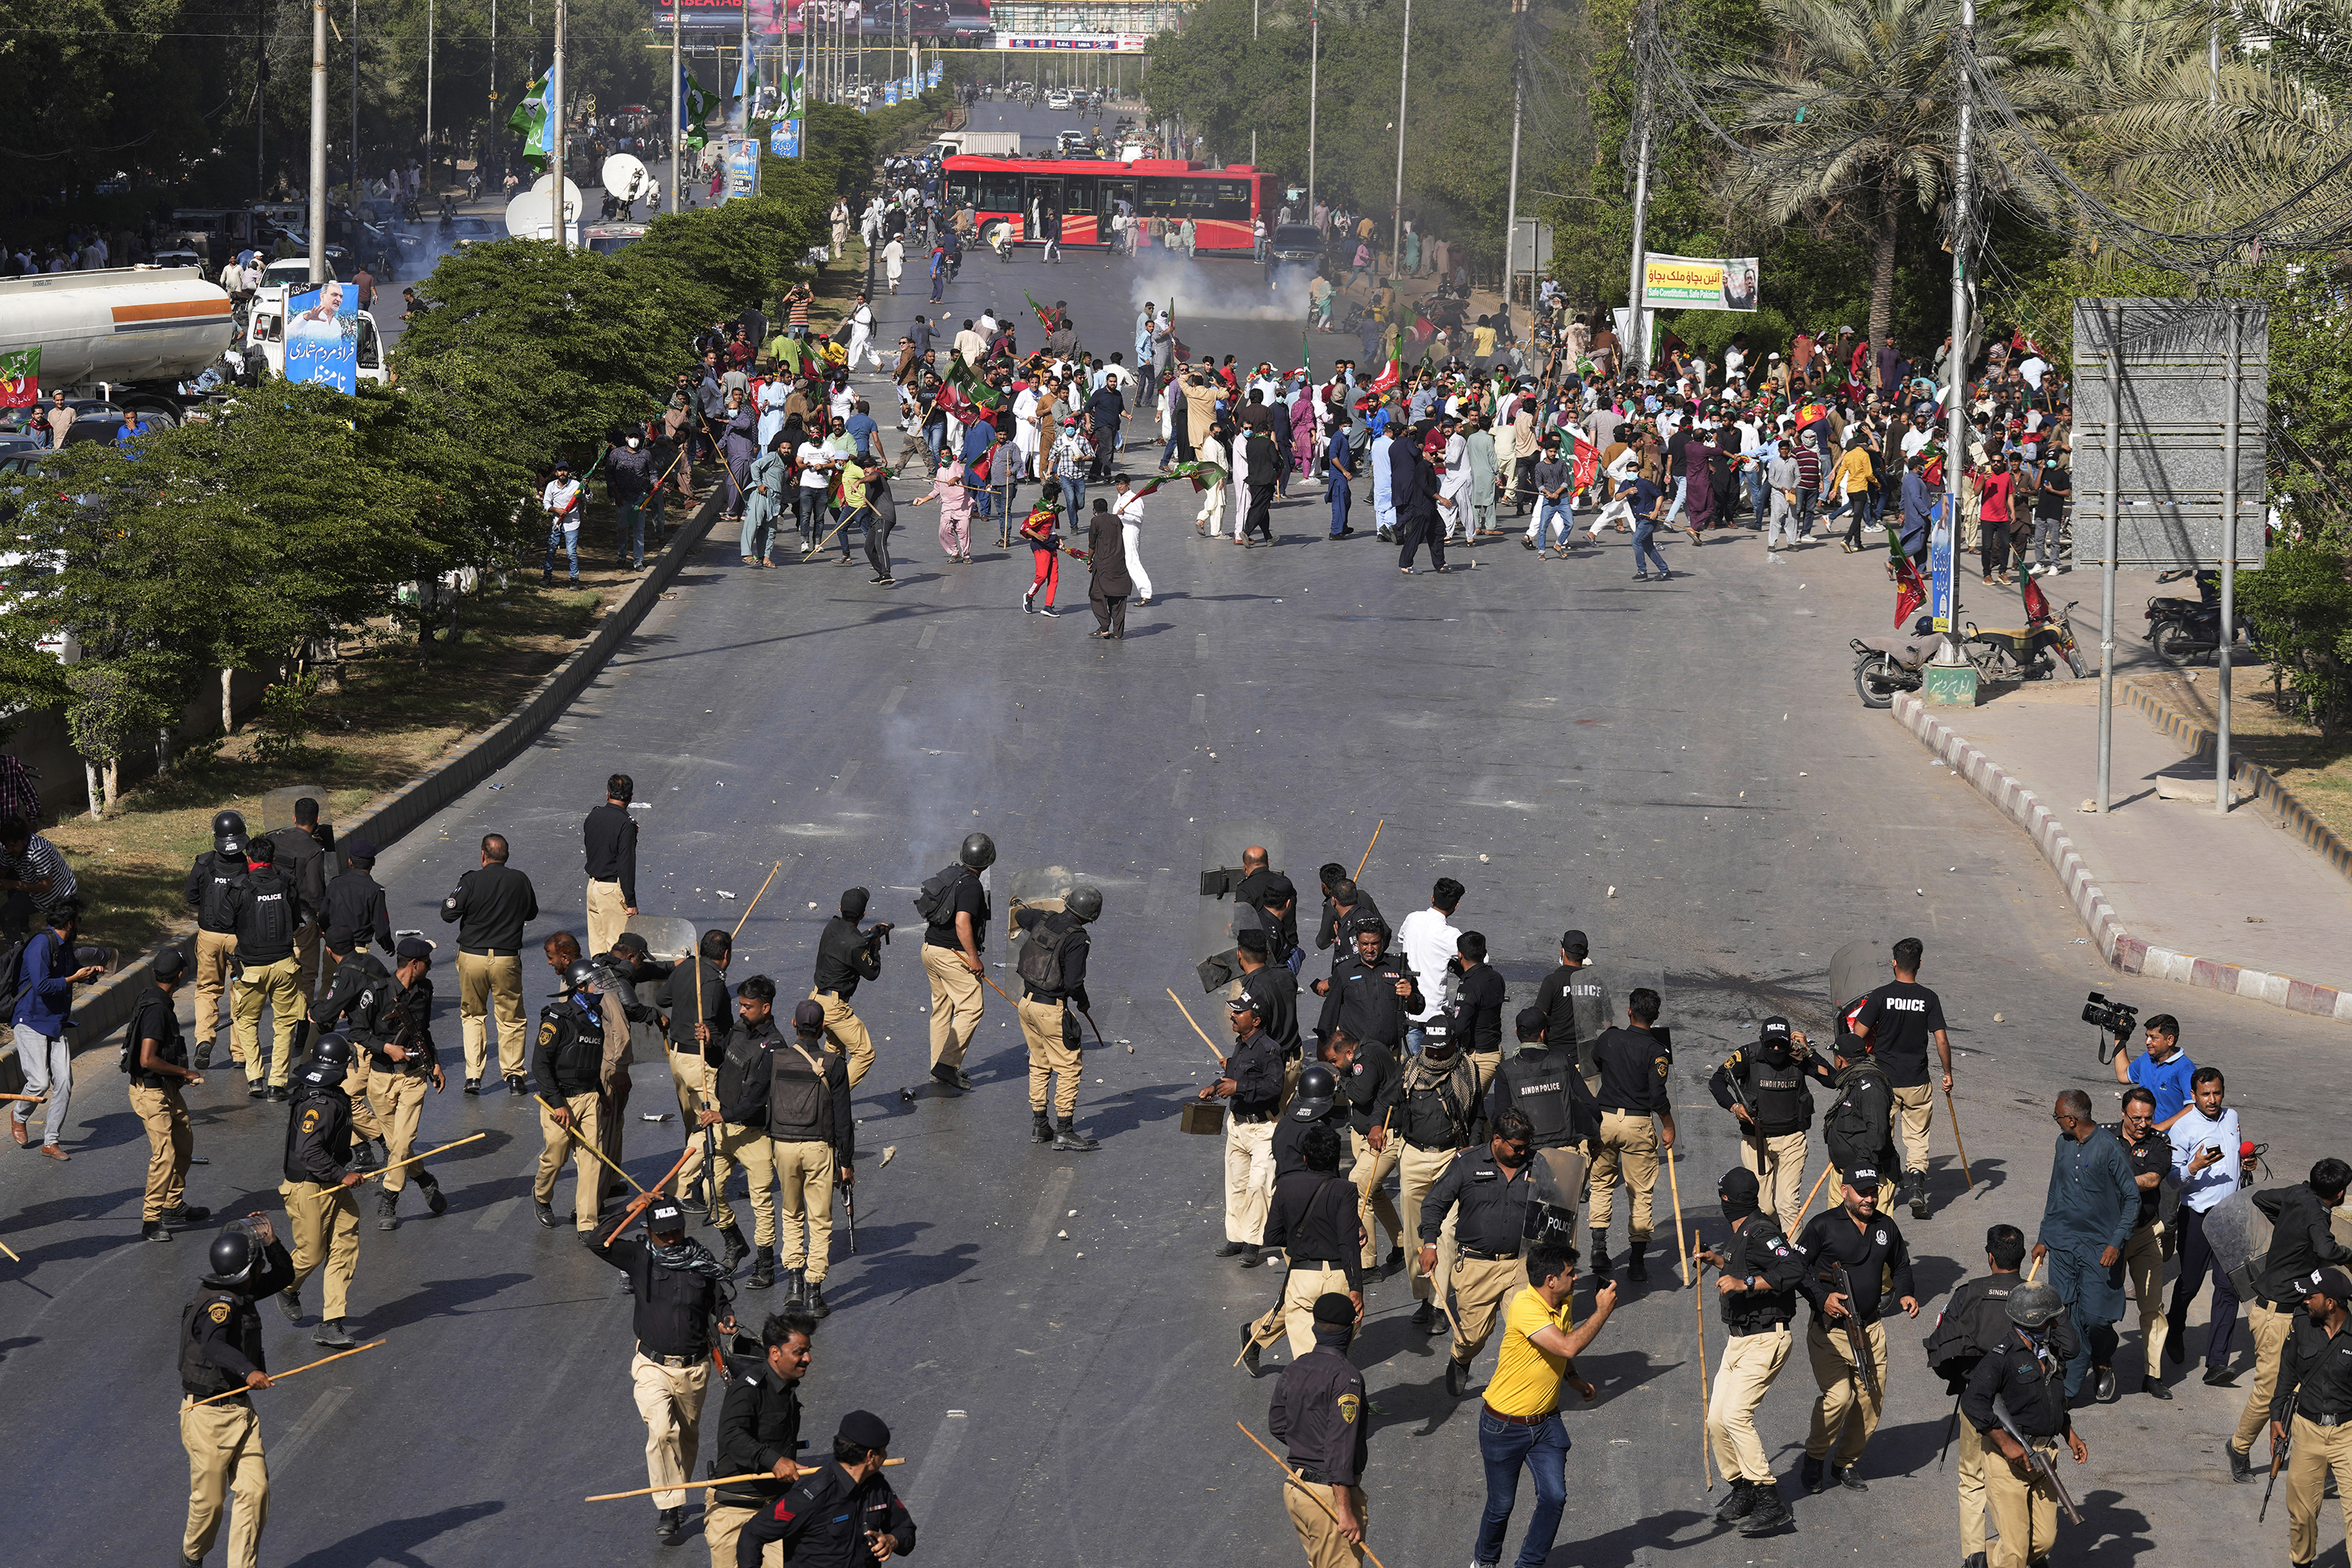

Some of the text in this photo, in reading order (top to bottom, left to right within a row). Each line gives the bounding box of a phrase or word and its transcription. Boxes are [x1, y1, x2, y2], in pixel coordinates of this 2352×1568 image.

[1648, 287, 1719, 299] Safe Constitution, Safe Pakistan
[257, 893, 282, 902] POLICE
[1563, 985, 1601, 997] POLICE
[1886, 997, 1926, 1012] POLICE
[1425, 1026, 1446, 1036] POLICE
[1766, 1023, 1786, 1032] POLICE
[579, 1036, 601, 1044] POLICE
[1521, 1082, 1560, 1095] SINDH POLICE
[1855, 1169, 1877, 1178] POLICE
[654, 1206, 678, 1220] POLICE
[1548, 1216, 1571, 1234] POLICE
[2294, 1281, 2307, 1294] POLICE
